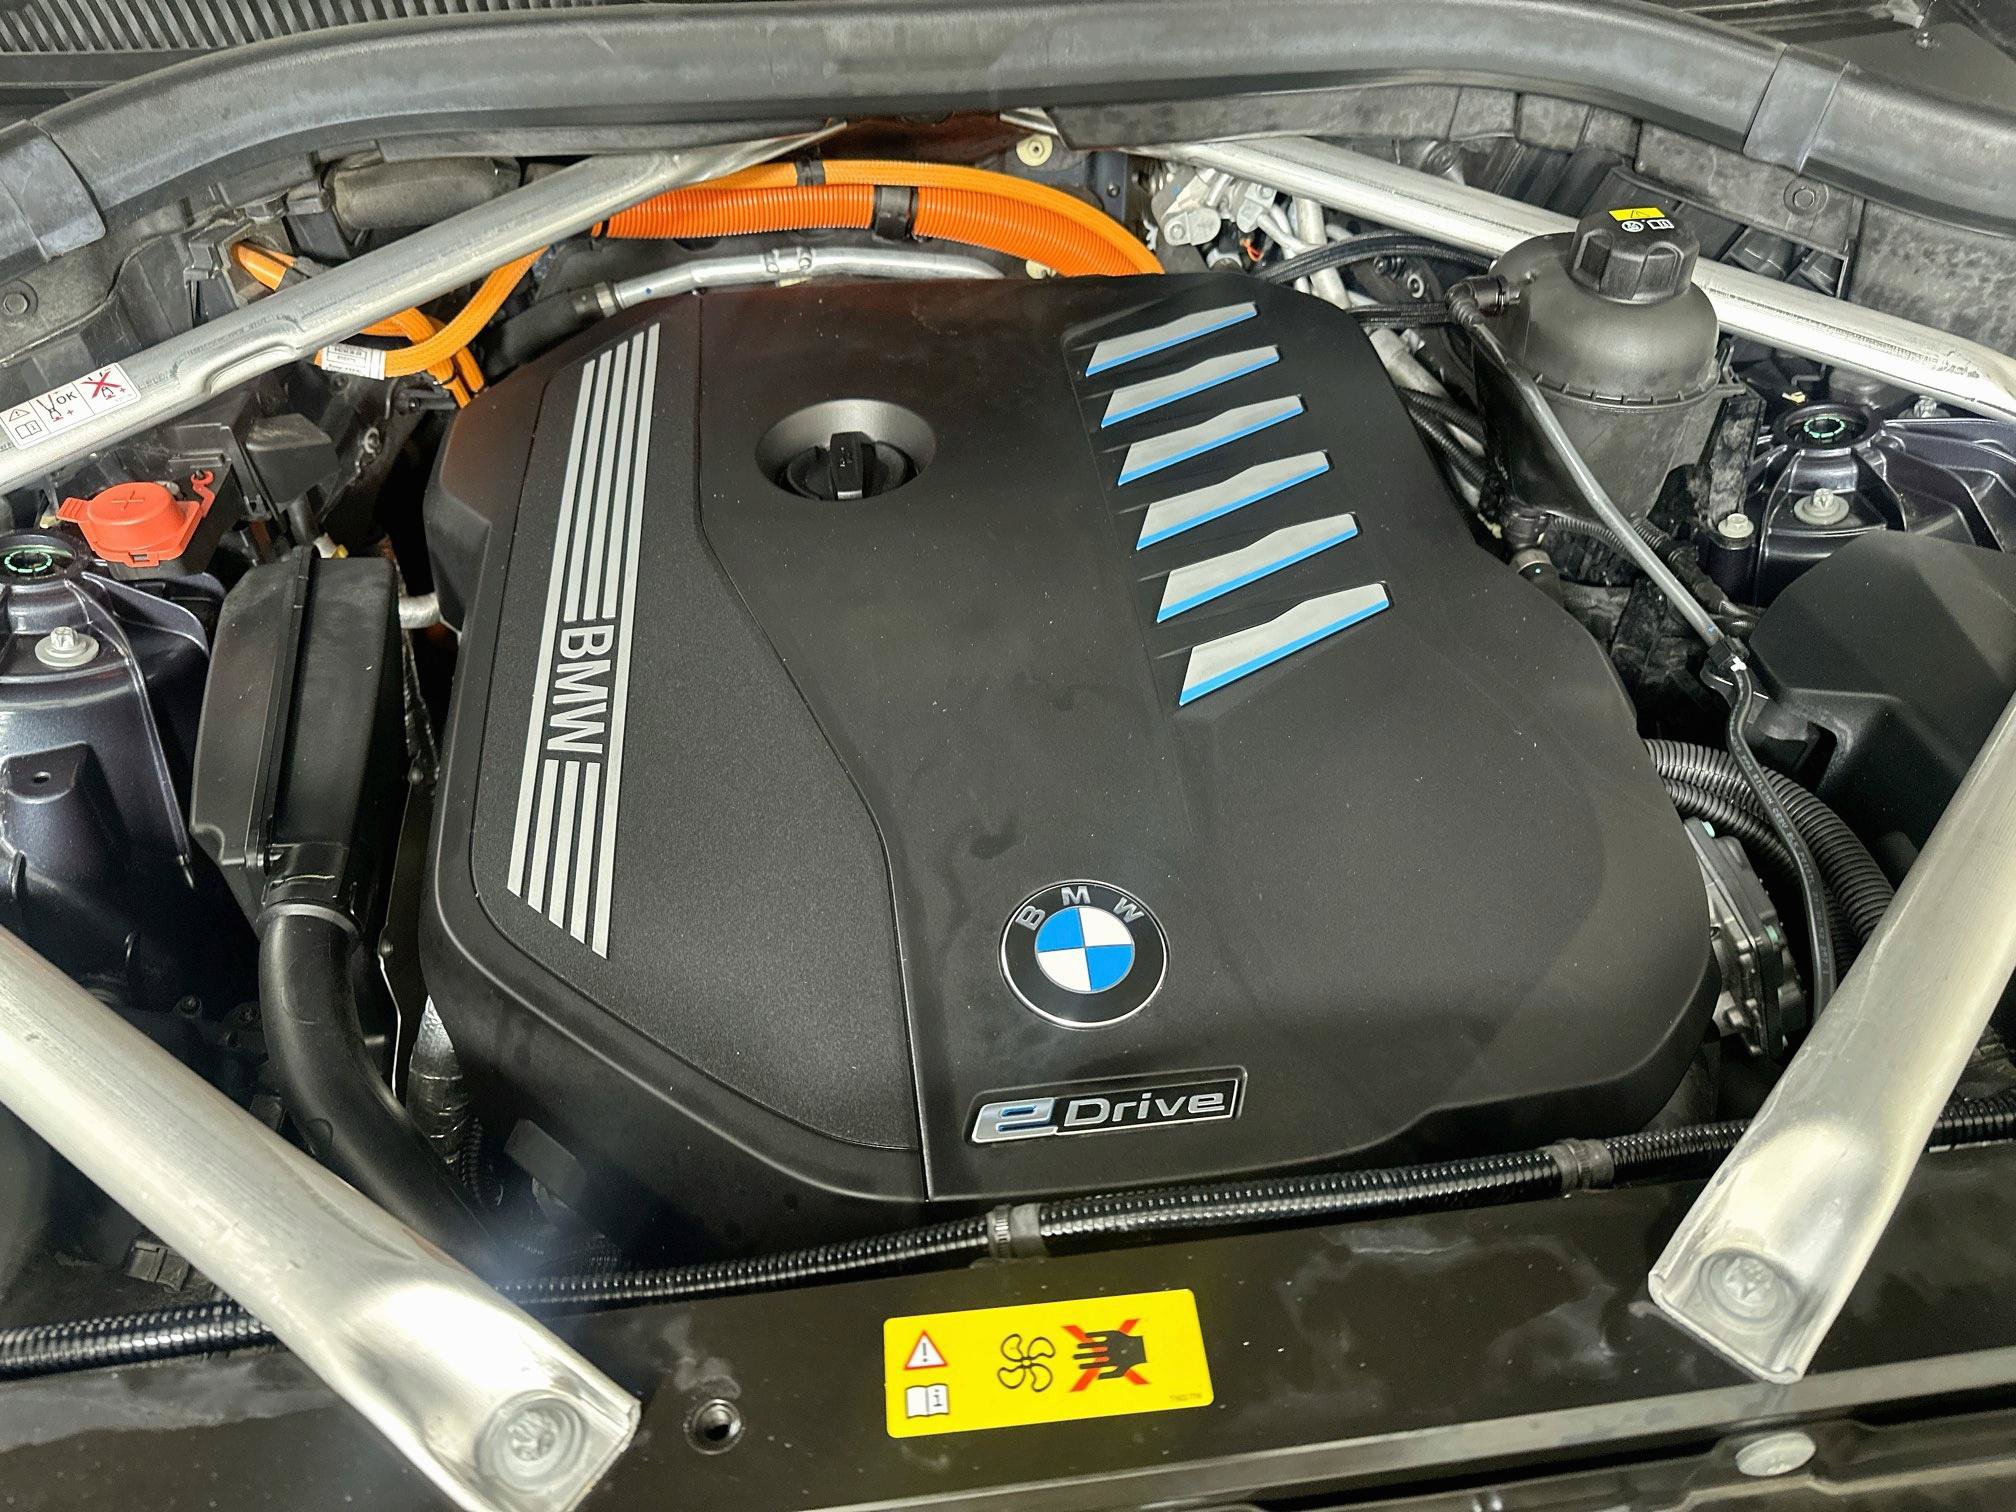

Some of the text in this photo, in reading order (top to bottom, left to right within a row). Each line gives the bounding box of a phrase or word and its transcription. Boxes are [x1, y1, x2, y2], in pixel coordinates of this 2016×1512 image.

[56, 391, 78, 405] OK
[547, 624, 615, 754] BMW
[1015, 885, 1145, 931] BMW
